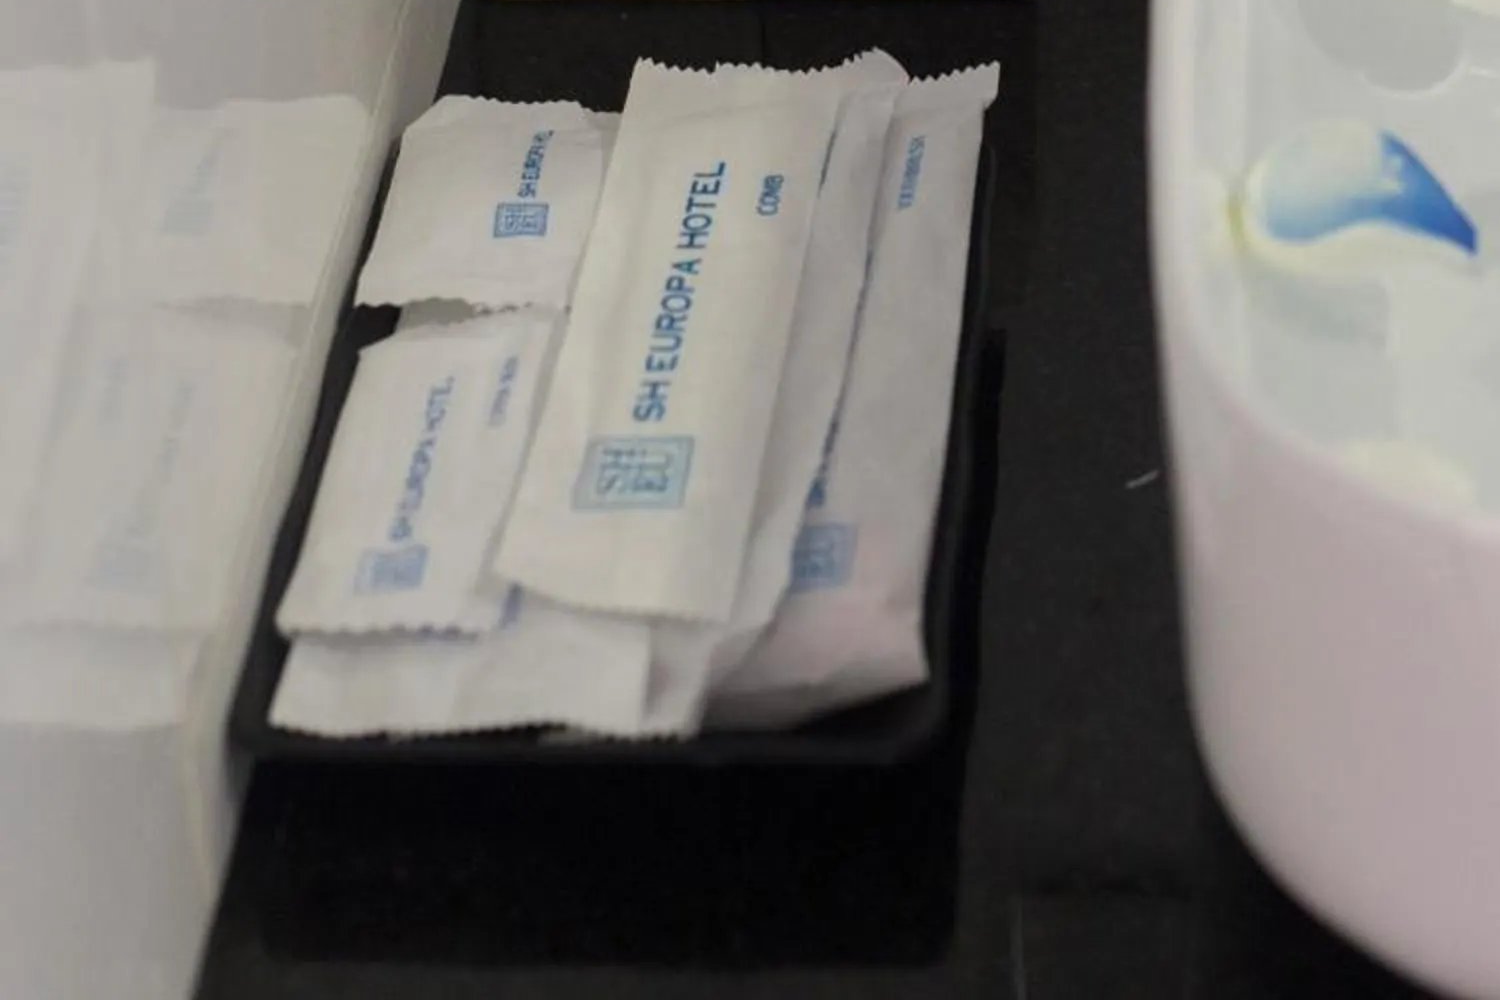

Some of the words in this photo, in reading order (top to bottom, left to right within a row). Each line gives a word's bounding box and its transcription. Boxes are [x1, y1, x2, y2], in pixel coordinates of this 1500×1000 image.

[675, 161, 726, 250] HOTEL
[756, 174, 785, 216] COMB
[644, 257, 702, 372] EUROPA
[631, 380, 672, 422] SH
